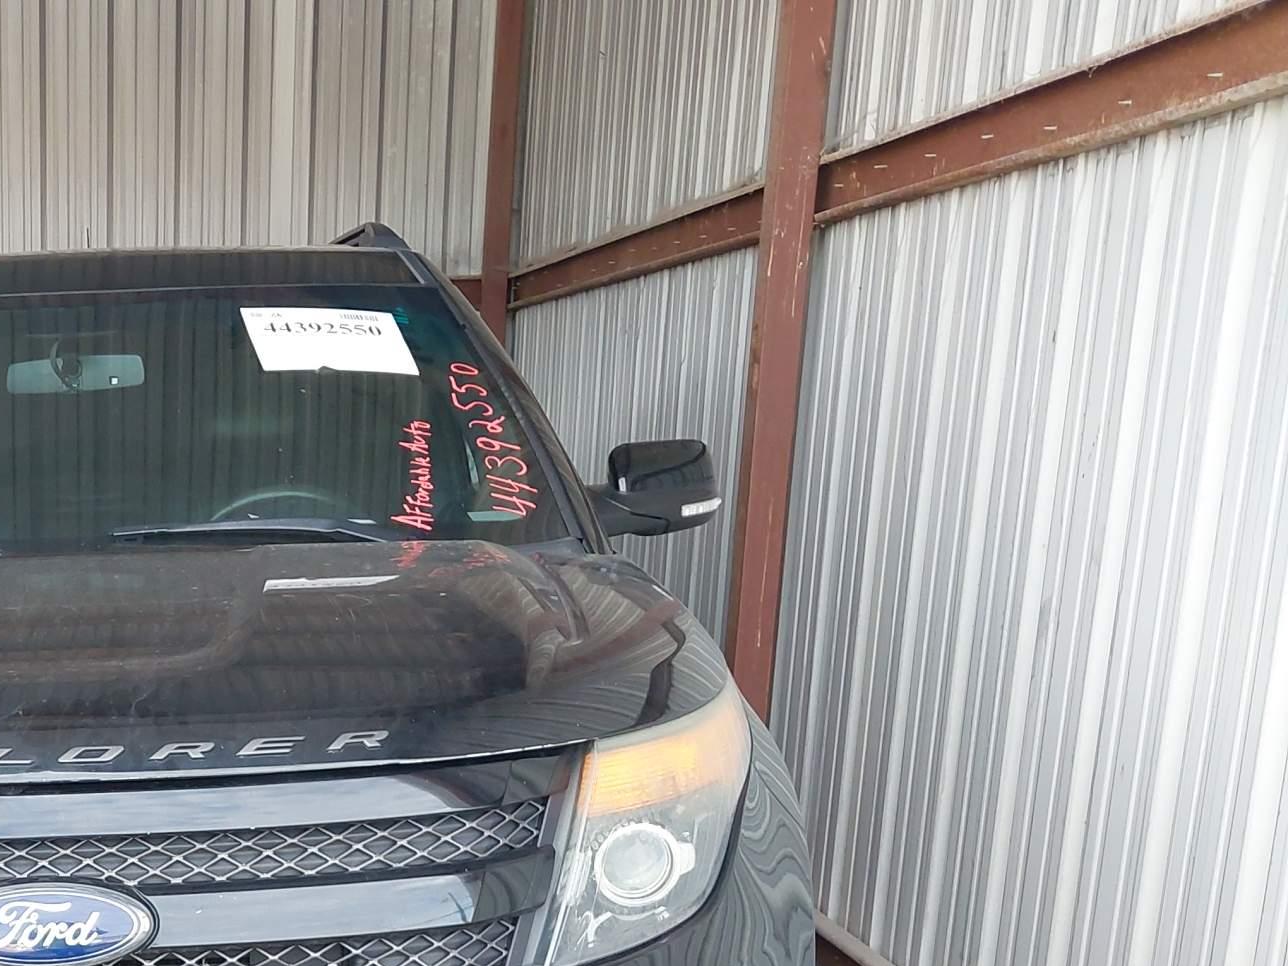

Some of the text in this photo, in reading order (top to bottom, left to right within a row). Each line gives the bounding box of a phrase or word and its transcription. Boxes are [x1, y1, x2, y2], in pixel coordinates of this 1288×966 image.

[264, 321, 383, 336] 44392550
[398, 420, 432, 455] Auto
[448, 362, 539, 517] 44392550
